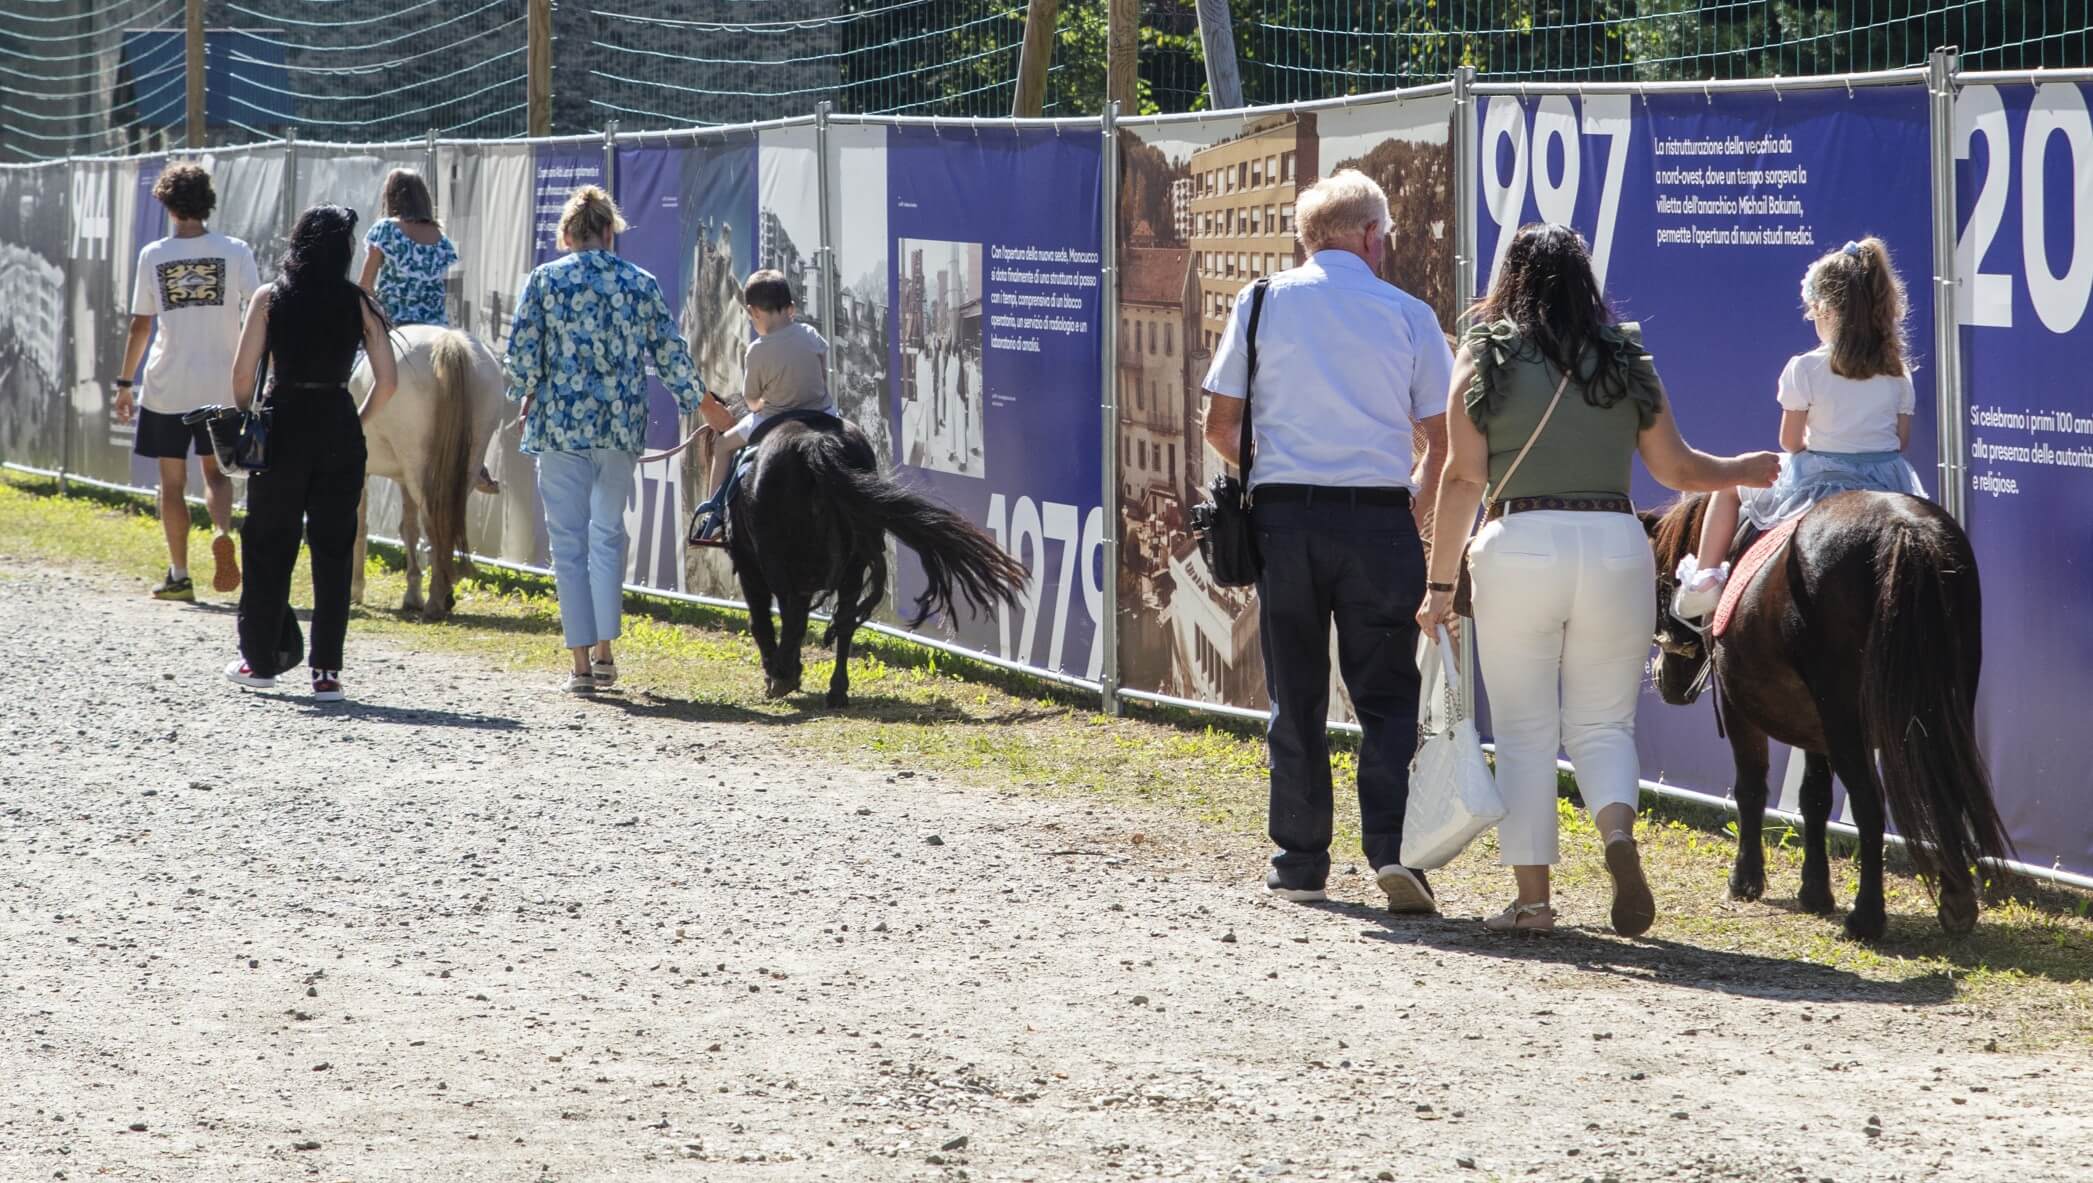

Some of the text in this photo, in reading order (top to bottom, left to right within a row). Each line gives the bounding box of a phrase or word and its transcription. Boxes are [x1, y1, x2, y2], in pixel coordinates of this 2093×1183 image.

[1655, 134, 1792, 155] La ristrutturazione della vecchia ala
[1656, 164, 1807, 190] a nord-ovest, dove un tempo sorgeva la
[1471, 95, 1631, 298] 997
[1656, 194, 1804, 218] villetta dell'anarchico Michail Bakunin,
[71, 162, 110, 260] 944
[1657, 224, 1815, 249] permette l'apertura di nuovi studi medici.
[991, 244, 1098, 264] Con l'apertura della nuova sede, Moncucco
[996, 267, 1007, 282] dota
[1008, 267, 1033, 283] finalmente
[1040, 273, 1050, 285] una
[1050, 271, 1072, 286] struttura
[1073, 271, 1079, 286] al
[1080, 276, 1096, 290] passo
[991, 293, 1000, 304] con
[1003, 290, 1018, 308] tempi,
[1056, 297, 1063, 308] un
[1064, 293, 1082, 310] blocco
[991, 313, 1016, 330] operatorio,
[1017, 317, 1023, 329] un
[1024, 314, 1043, 330] servizio
[1049, 316, 1075, 335] radiologia
[1080, 321, 1088, 333] un
[991, 333, 1016, 350] laboratorio
[1022, 337, 1040, 352] analisi.
[1970, 404, 1979, 426] Si
[1980, 405, 2025, 430] celebrano
[2030, 409, 2055, 436] primi
[2056, 411, 2073, 433] 100
[1971, 437, 1988, 459] alla
[1989, 444, 2030, 465] presenza
[2031, 442, 2054, 465] delle
[1972, 470, 2020, 498] e religiose.
[986, 493, 1103, 681] 1979
